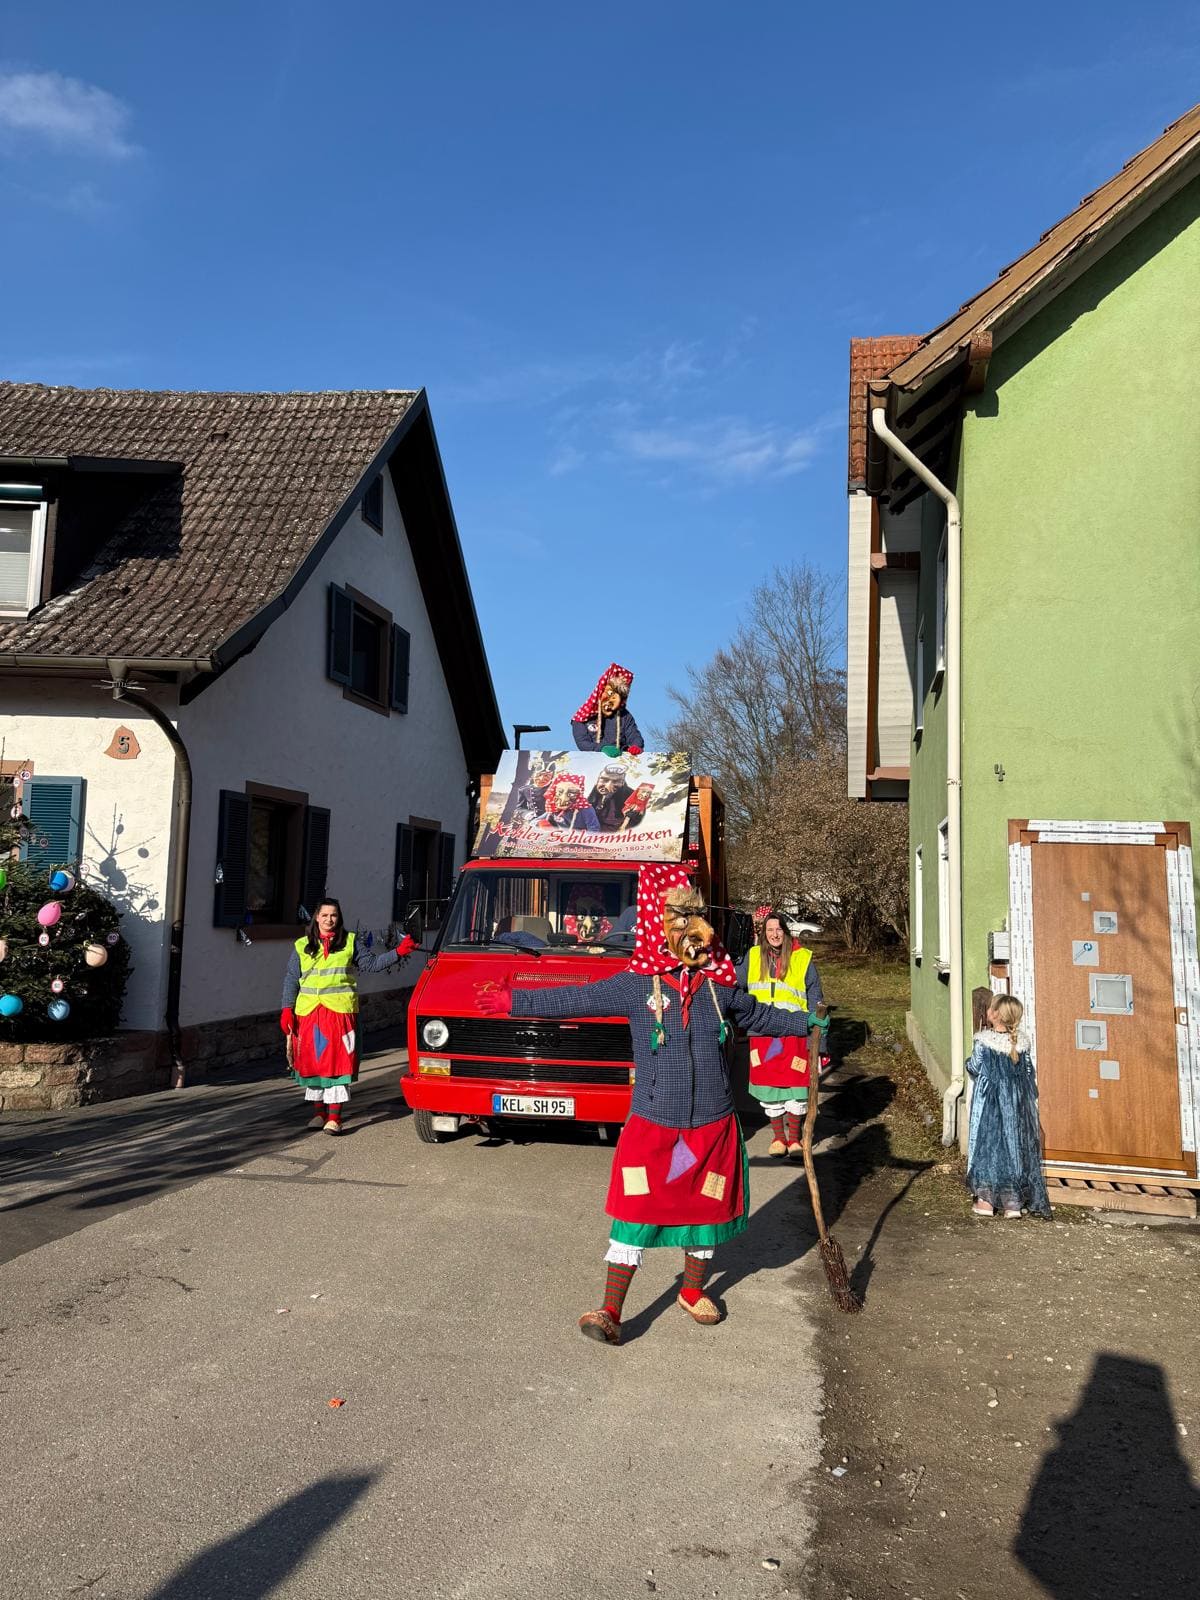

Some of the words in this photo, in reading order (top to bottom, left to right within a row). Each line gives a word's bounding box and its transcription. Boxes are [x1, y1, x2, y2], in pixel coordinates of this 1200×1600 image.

[118, 736, 130, 754] 5
[994, 764, 1006, 782] 4
[491, 822, 544, 842] Kehler
[547, 827, 673, 844] Schlammhexen
[502, 1098, 524, 1112] KEL
[533, 1100, 548, 1113] SH
[551, 1101, 566, 1114] 95
